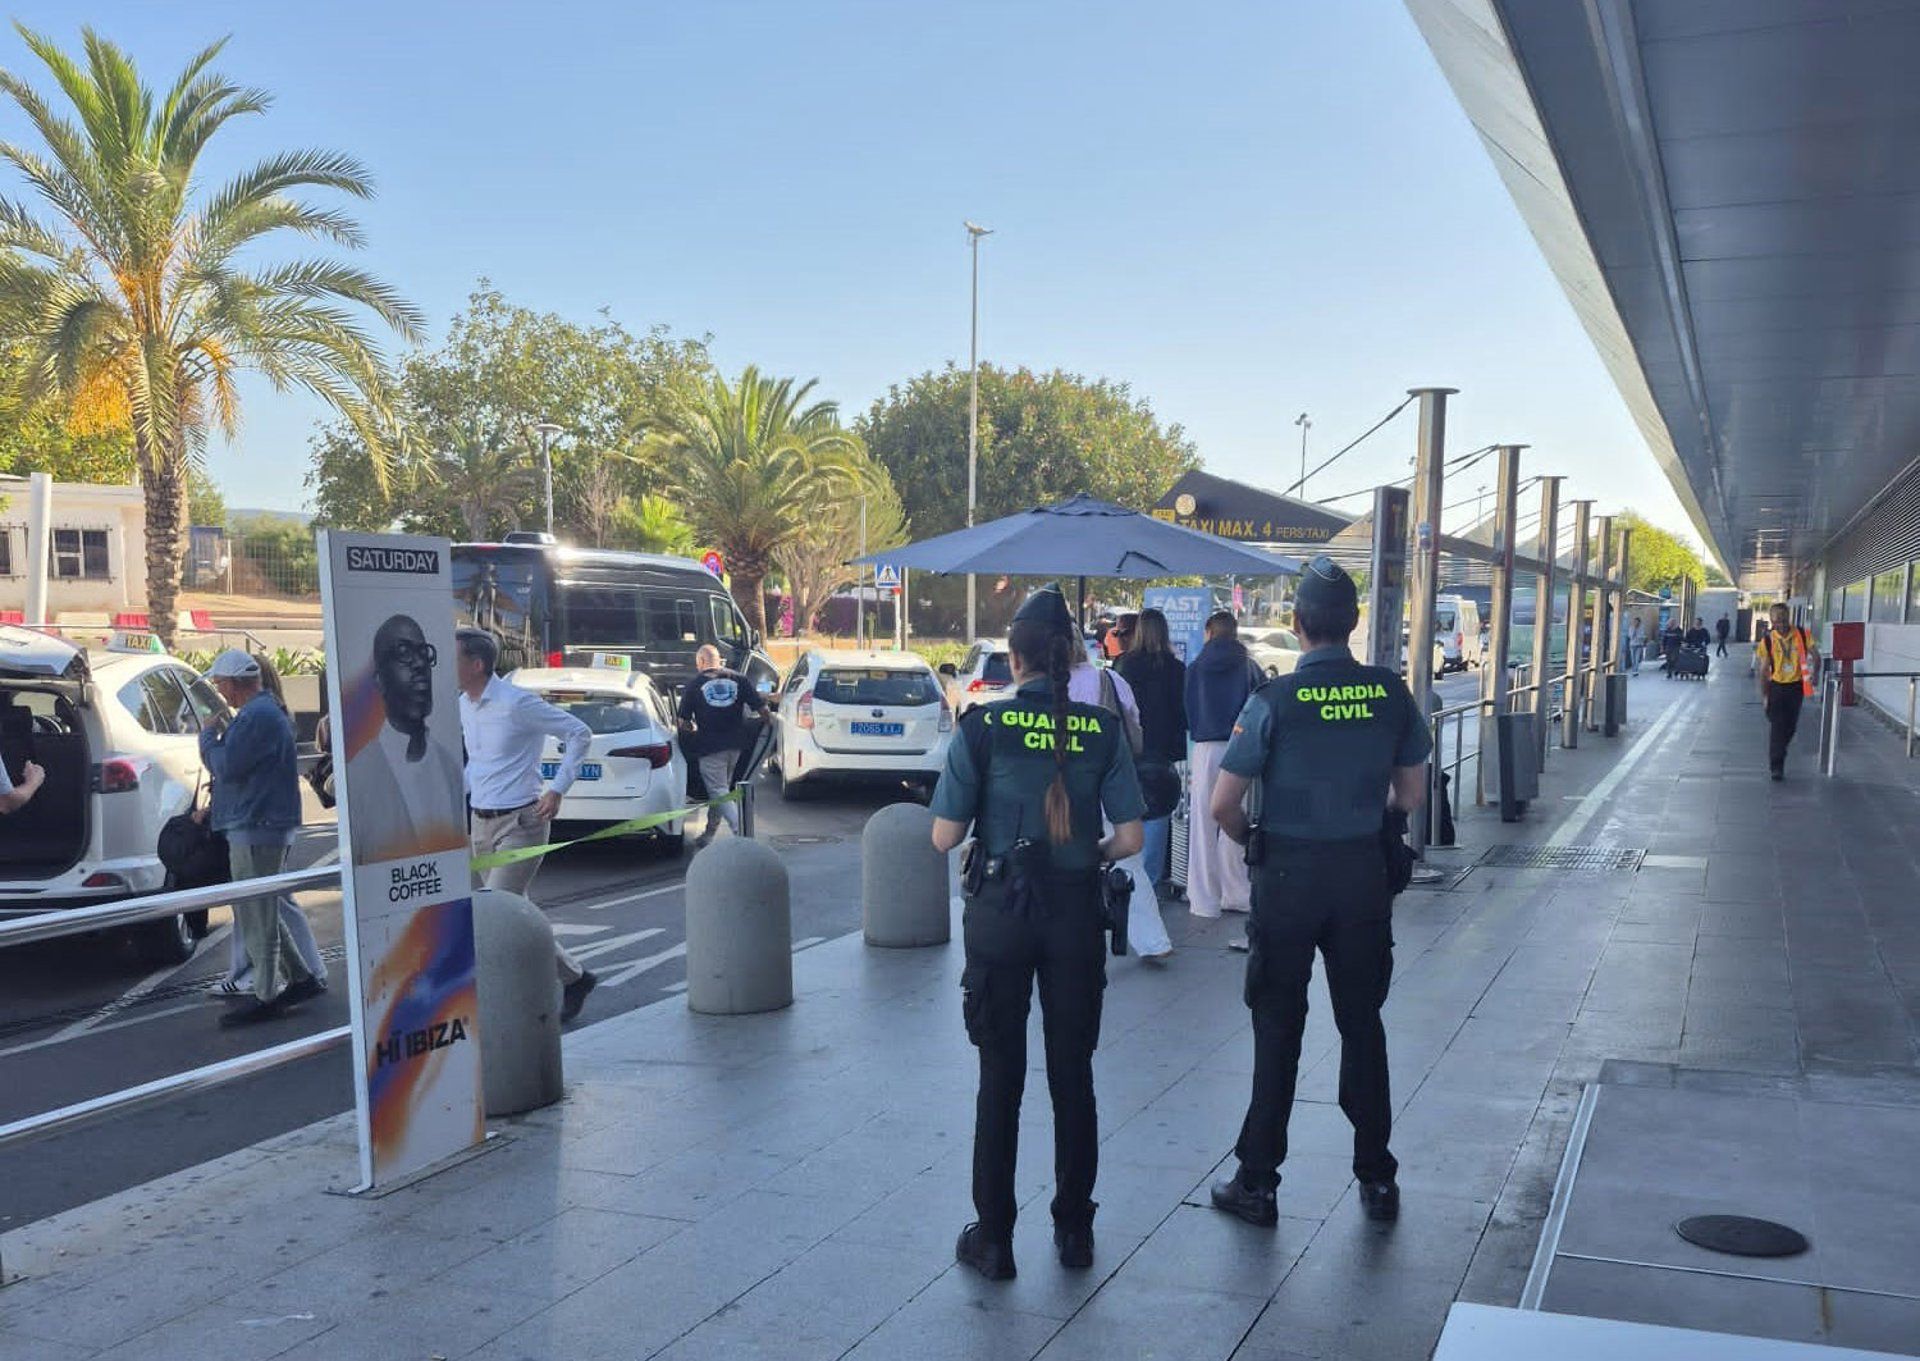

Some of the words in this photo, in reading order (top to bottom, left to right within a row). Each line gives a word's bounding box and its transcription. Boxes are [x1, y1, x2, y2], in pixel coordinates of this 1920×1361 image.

[1179, 519, 1214, 535] TAXI
[1218, 519, 1257, 537] MAX.
[1262, 520, 1272, 537] 4
[1277, 526, 1330, 539] PERS/TAXI
[350, 548, 435, 571] SATURDAY
[127, 633, 152, 650] TAXI
[1296, 683, 1388, 702] GUARDIA
[1001, 711, 1101, 733] GUADIA
[1320, 703, 1373, 720] CIVIL
[391, 861, 438, 883] BLACK
[389, 878, 442, 902] COFFEE
[405, 1018, 467, 1059] IBIZA
